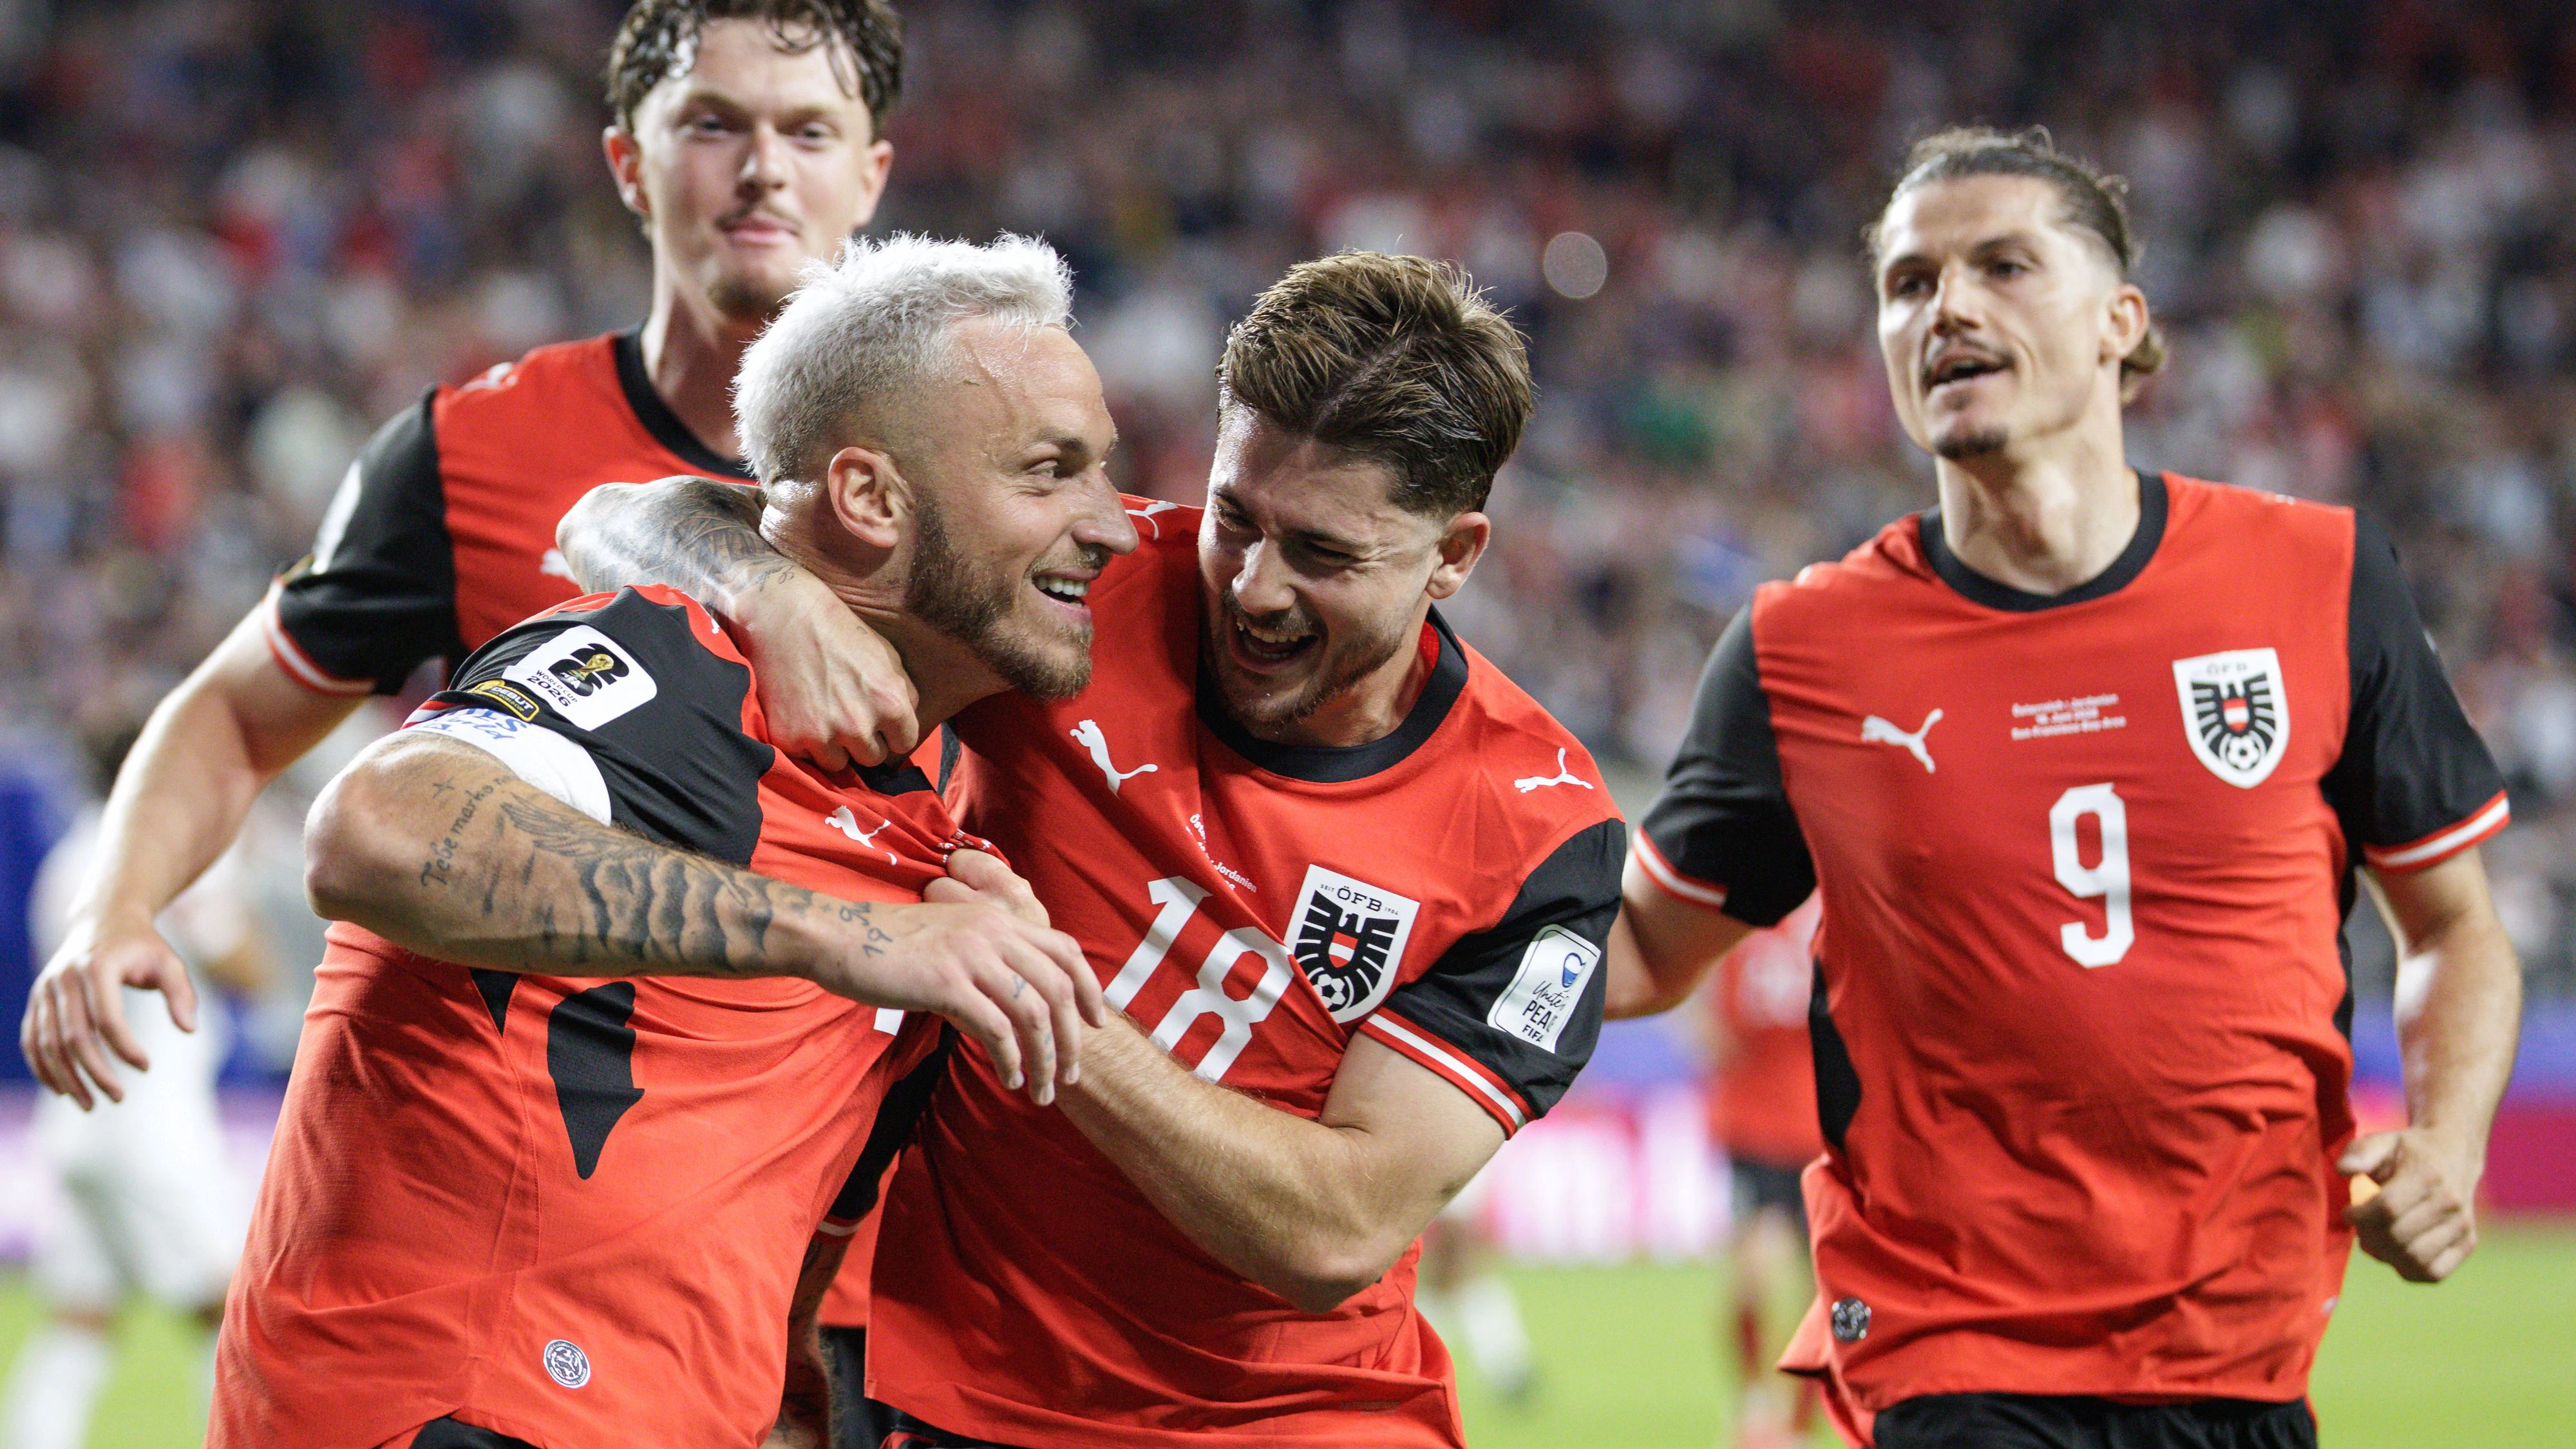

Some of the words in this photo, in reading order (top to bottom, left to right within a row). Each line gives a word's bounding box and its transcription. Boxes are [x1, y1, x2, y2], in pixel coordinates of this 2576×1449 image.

[491, 686, 535, 710] DEBUT
[526, 675, 571, 707] 2026
[535, 669, 563, 690] WORLD
[562, 689, 578, 703] CUP
[1213, 862, 1257, 893] Jordanien
[2049, 781, 2136, 969] 9
[1336, 885, 1383, 912] ÖFB
[1102, 875, 1296, 1085] 18
